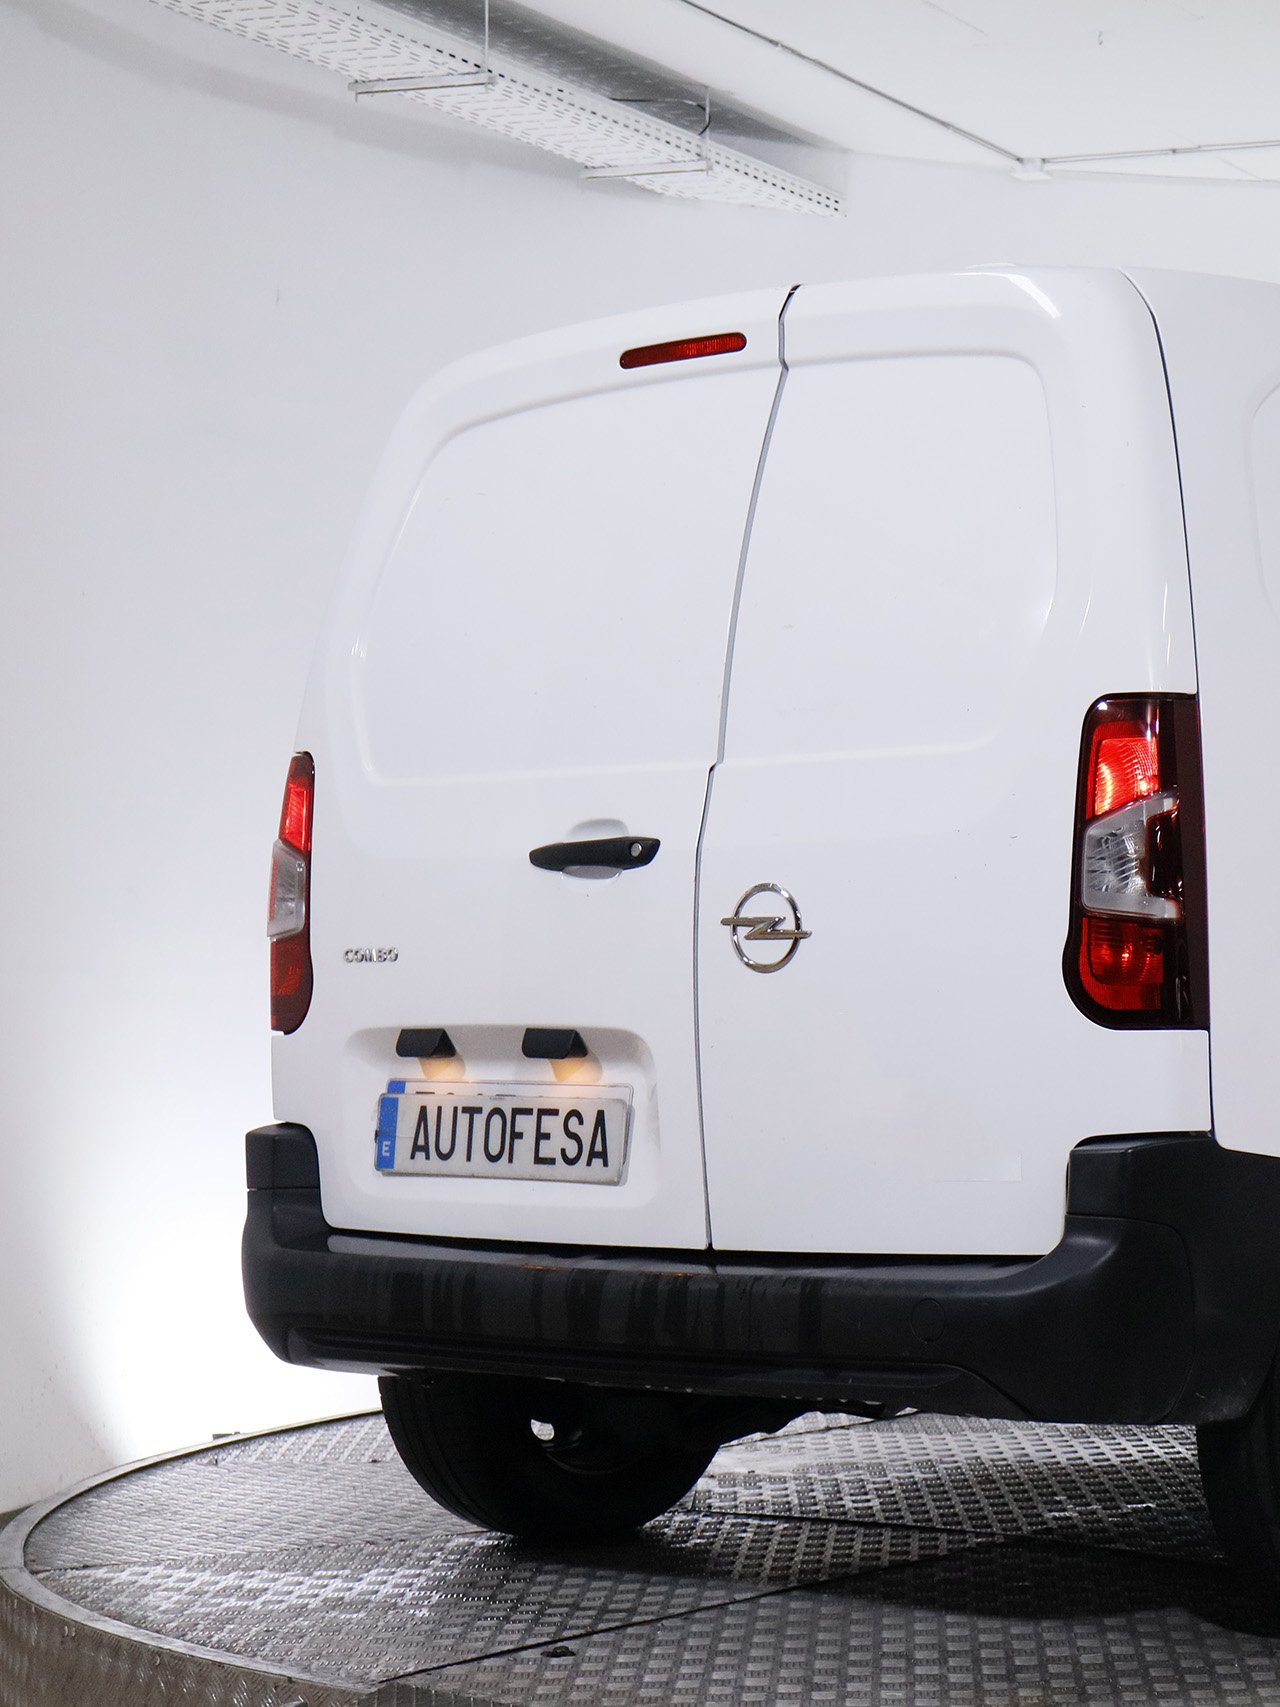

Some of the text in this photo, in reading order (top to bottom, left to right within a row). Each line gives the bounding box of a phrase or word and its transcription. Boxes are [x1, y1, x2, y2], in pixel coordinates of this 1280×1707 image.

[344, 947, 399, 963] COMBO
[382, 1105, 609, 1168] E AUTOFESA
